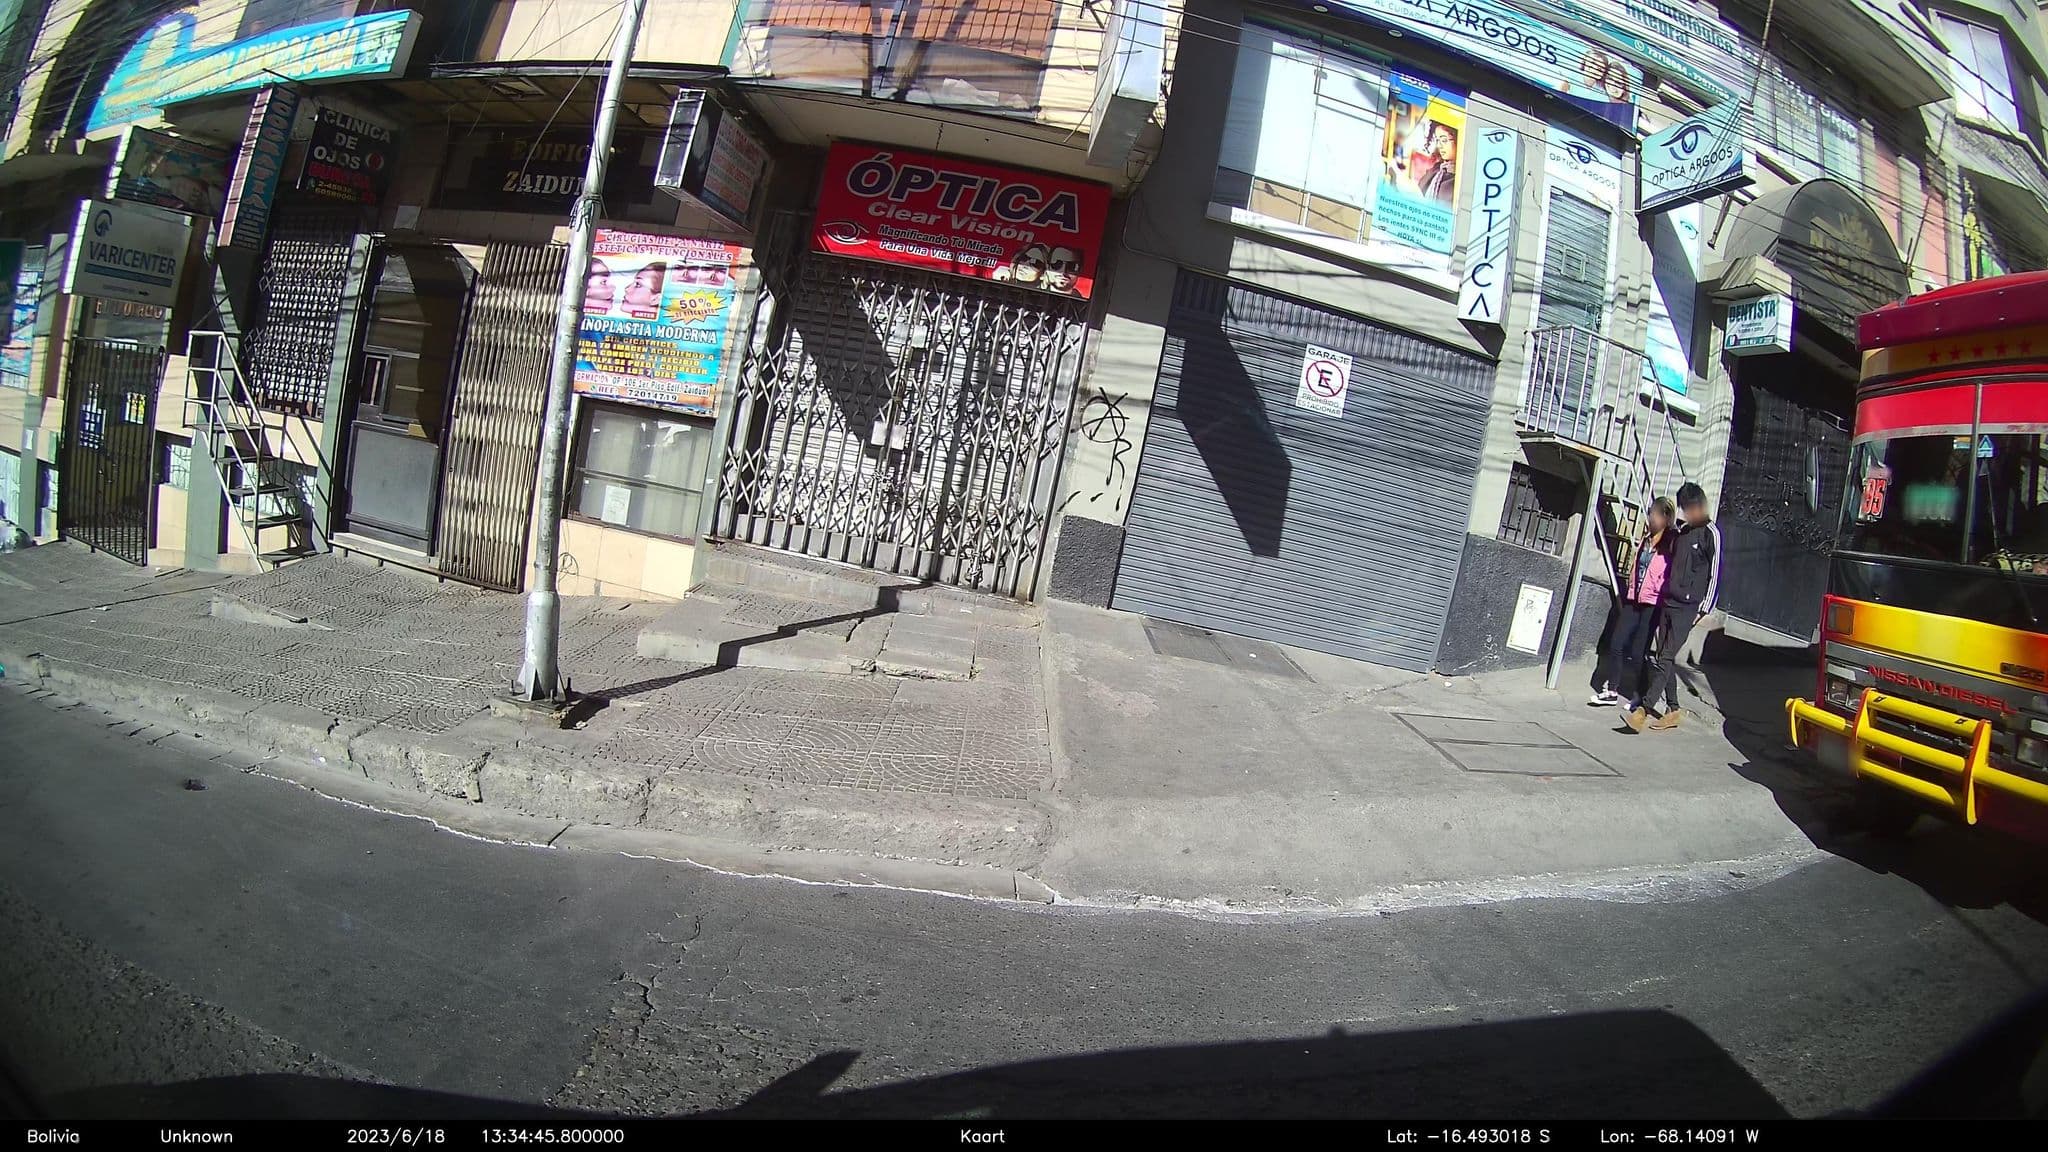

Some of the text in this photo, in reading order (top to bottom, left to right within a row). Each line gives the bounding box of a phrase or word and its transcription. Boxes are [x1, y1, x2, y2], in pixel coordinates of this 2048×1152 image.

[1444, 3, 1559, 66] ARGOOS
[324, 110, 392, 144] CLINICA
[334, 132, 358, 150] DE
[511, 140, 587, 162] EDIFIC
[313, 145, 361, 170] OJOS
[1652, 146, 1734, 185] OPTICA ARGOOS
[502, 170, 585, 196] ZAIDUN
[847, 152, 1080, 233] ÓPTICA
[1378, 205, 1401, 217] hechos
[1402, 214, 1417, 222] para
[1380, 195, 1408, 209] Nuestros
[1408, 206, 1422, 215] ojos
[1422, 210, 1431, 218] no
[868, 201, 1036, 243] Clear Visión
[1378, 214, 1389, 223] Los
[1411, 225, 1429, 236] SYNC
[878, 224, 949, 247] Magnificando
[966, 237, 1004, 255] Mirada
[1467, 157, 1508, 318] OPTICA
[89, 240, 176, 276] VARICENTER
[658, 247, 733, 261] FUNCIONALES
[879, 239, 906, 254] Para
[906, 243, 928, 256] Una
[930, 247, 954, 261] Vida
[679, 298, 712, 310] 50%
[1728, 300, 1776, 323] DENTISTA
[581, 318, 717, 345] INOPLASTIA MODERNA
[580, 347, 598, 356] UNA
[600, 349, 646, 360] CONSULTA
[612, 343, 648, 353] IMAGEN
[651, 348, 705, 360] ACUDIENDO
[1308, 347, 1350, 365] GARAJE
[596, 363, 626, 374] HASTA
[627, 367, 643, 375] LOS
[654, 370, 677, 379] DIAS
[614, 358, 626, 366] SE
[628, 359, 656, 369] PUEDE
[576, 372, 609, 384] ORMACION
[1868, 663, 2018, 715] NISSAN DIESEL
